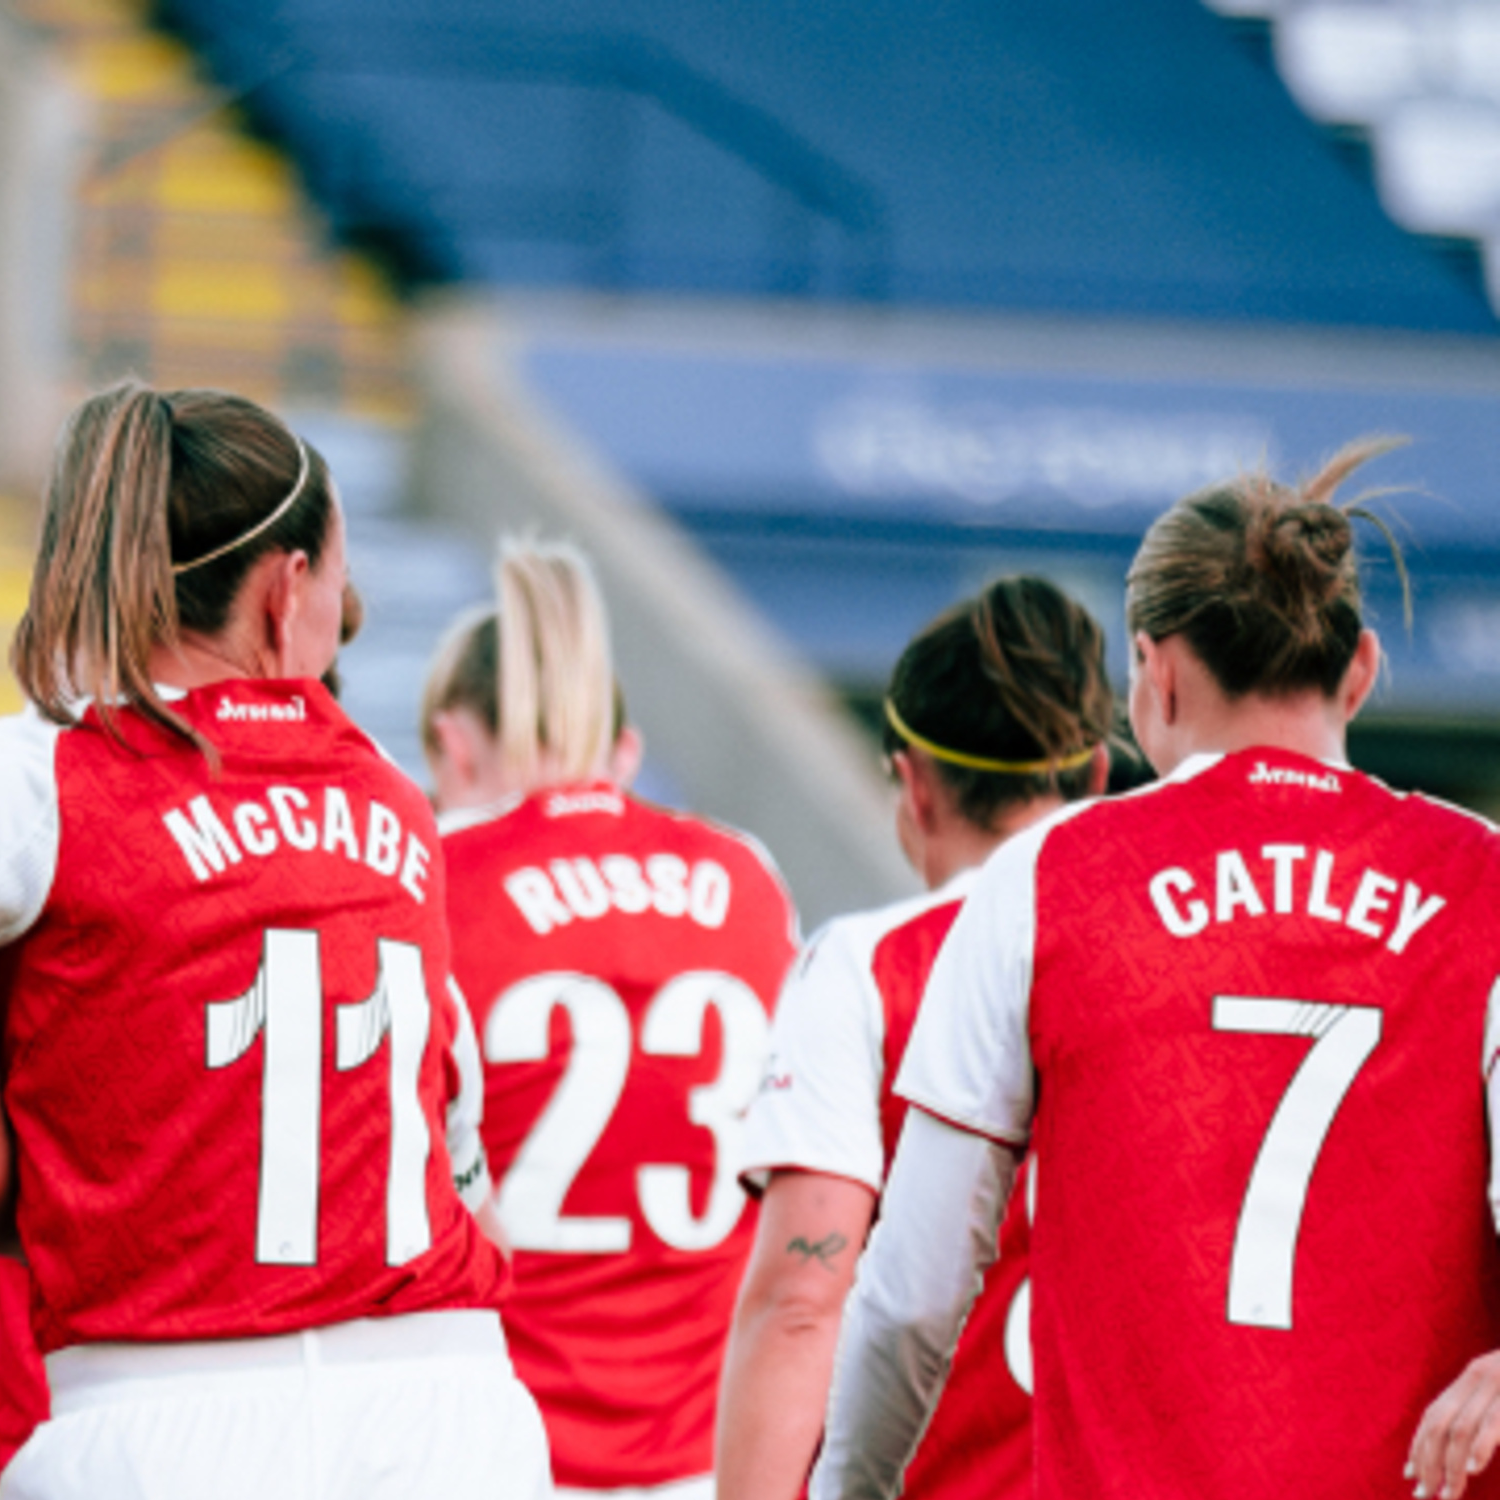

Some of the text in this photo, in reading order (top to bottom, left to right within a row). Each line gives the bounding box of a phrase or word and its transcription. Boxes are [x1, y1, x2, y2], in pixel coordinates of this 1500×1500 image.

[216, 695, 306, 720] Arsenal
[1248, 761, 1343, 793] Arsenal
[161, 785, 431, 905] McCABE
[503, 852, 733, 937] RUSSO
[1147, 843, 1446, 955] CATLEY
[205, 927, 432, 1268] 11
[483, 969, 769, 1254] 23
[1211, 994, 1384, 1331] 7
